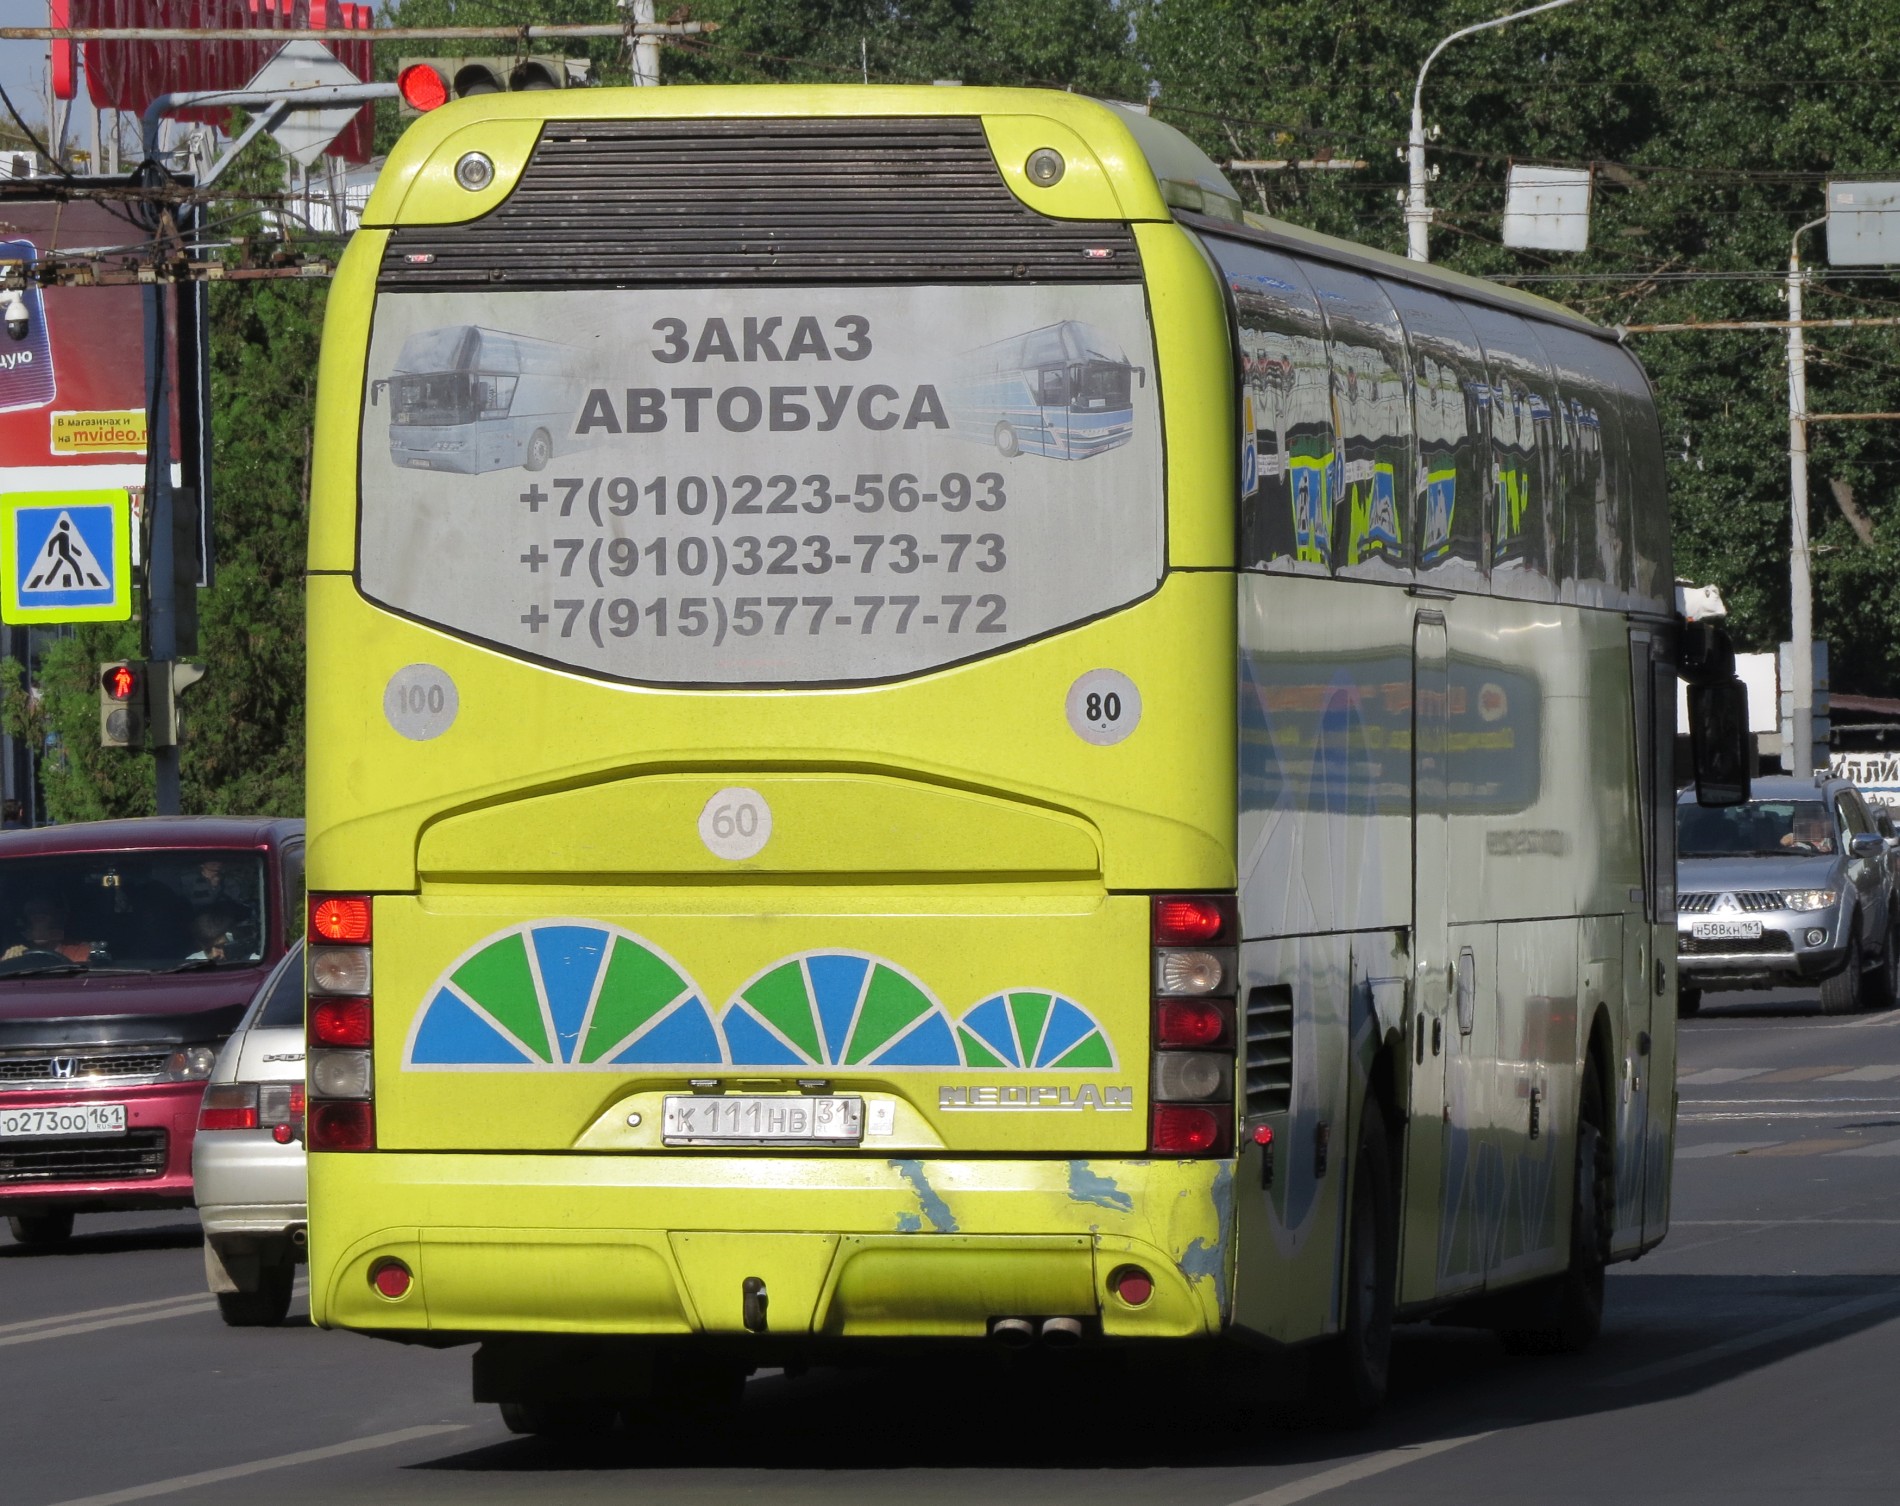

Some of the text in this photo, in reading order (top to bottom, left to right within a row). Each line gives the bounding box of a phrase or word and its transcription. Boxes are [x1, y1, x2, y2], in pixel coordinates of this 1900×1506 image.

[651, 314, 873, 364] ЗАКАЗ
[57, 417, 131, 428] В магазинах и
[575, 384, 950, 435] АВТОБУСА
[519, 472, 1007, 527] +7(910)223-56-93
[519, 533, 1007, 588] +7(910)323-73-73
[519, 594, 1007, 649] +7(915)577-77-72
[398, 683, 445, 714] 100
[1086, 692, 1121, 721] 80
[712, 803, 759, 839] 60
[1742, 922, 1760, 932] 161
[818, 1100, 851, 1125] 31
[939, 1084, 1133, 1111] NEOPLAN
[89, 1107, 120, 1124] 161
